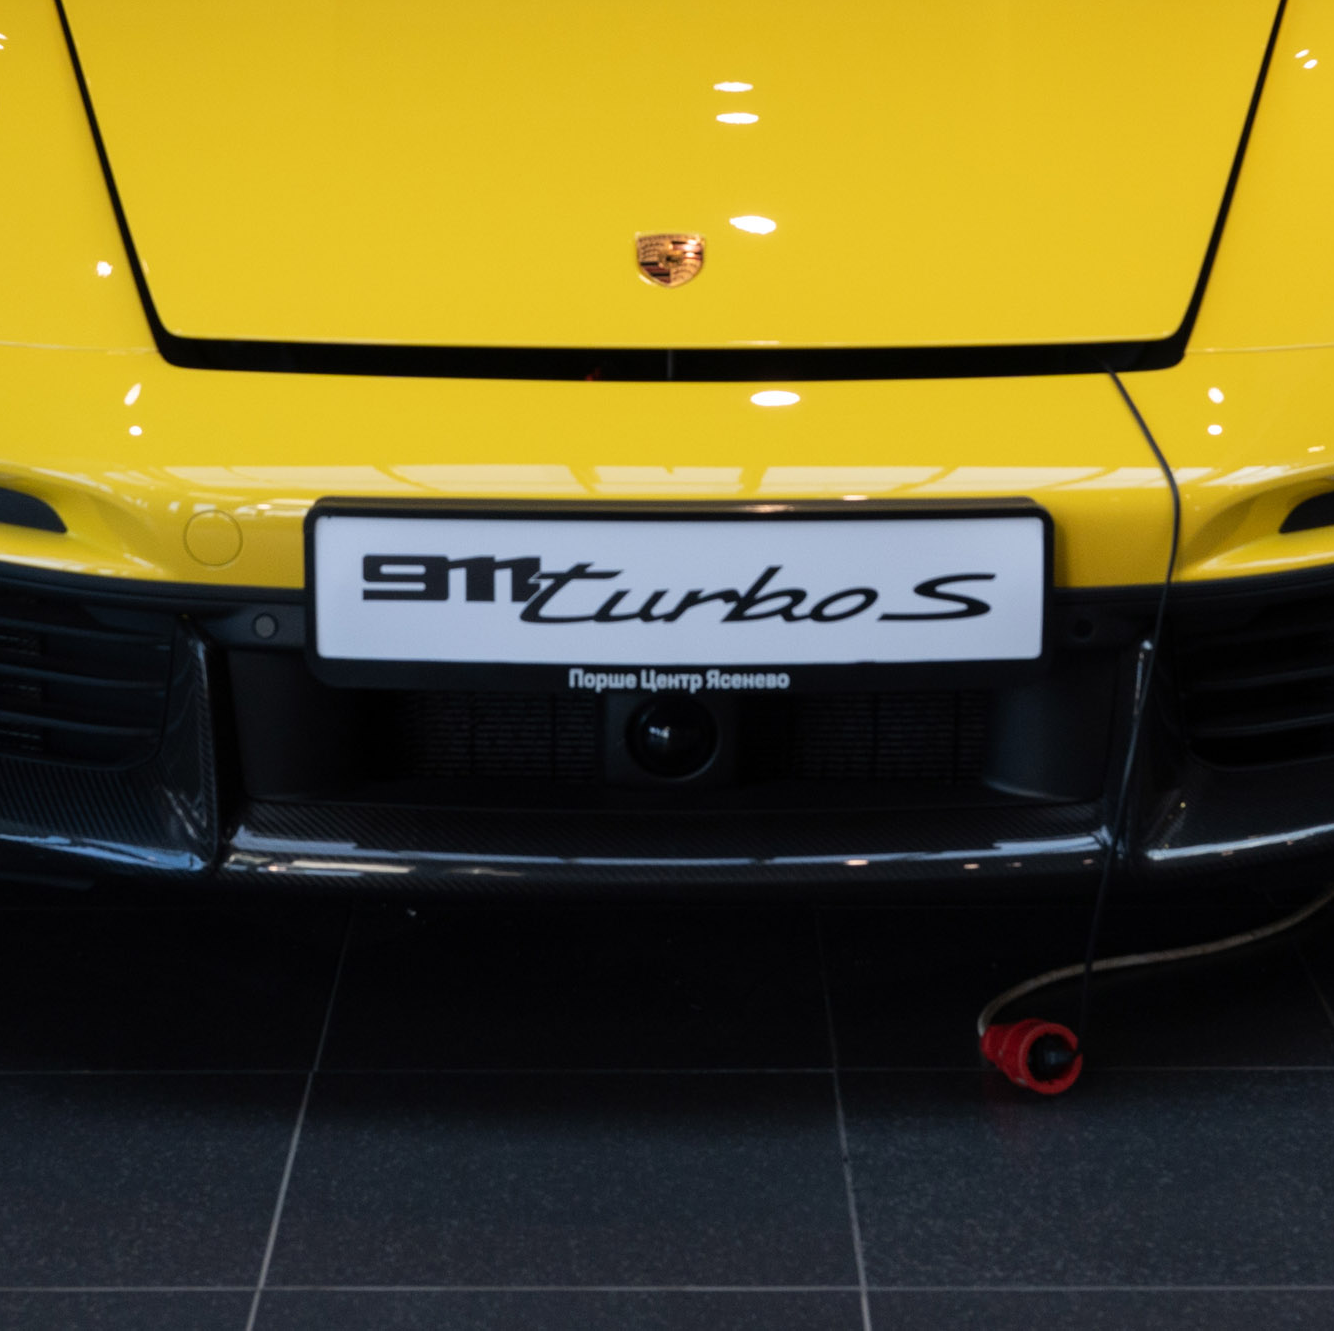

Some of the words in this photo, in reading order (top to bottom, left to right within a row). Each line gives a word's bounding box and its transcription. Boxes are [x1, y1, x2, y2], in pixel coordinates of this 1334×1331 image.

[362, 554, 543, 603] 911
[521, 561, 880, 625] turbo
[877, 573, 996, 622] S
[567, 668, 637, 692] Порше
[641, 668, 703, 693] Центр
[706, 668, 790, 691] Ясенево
